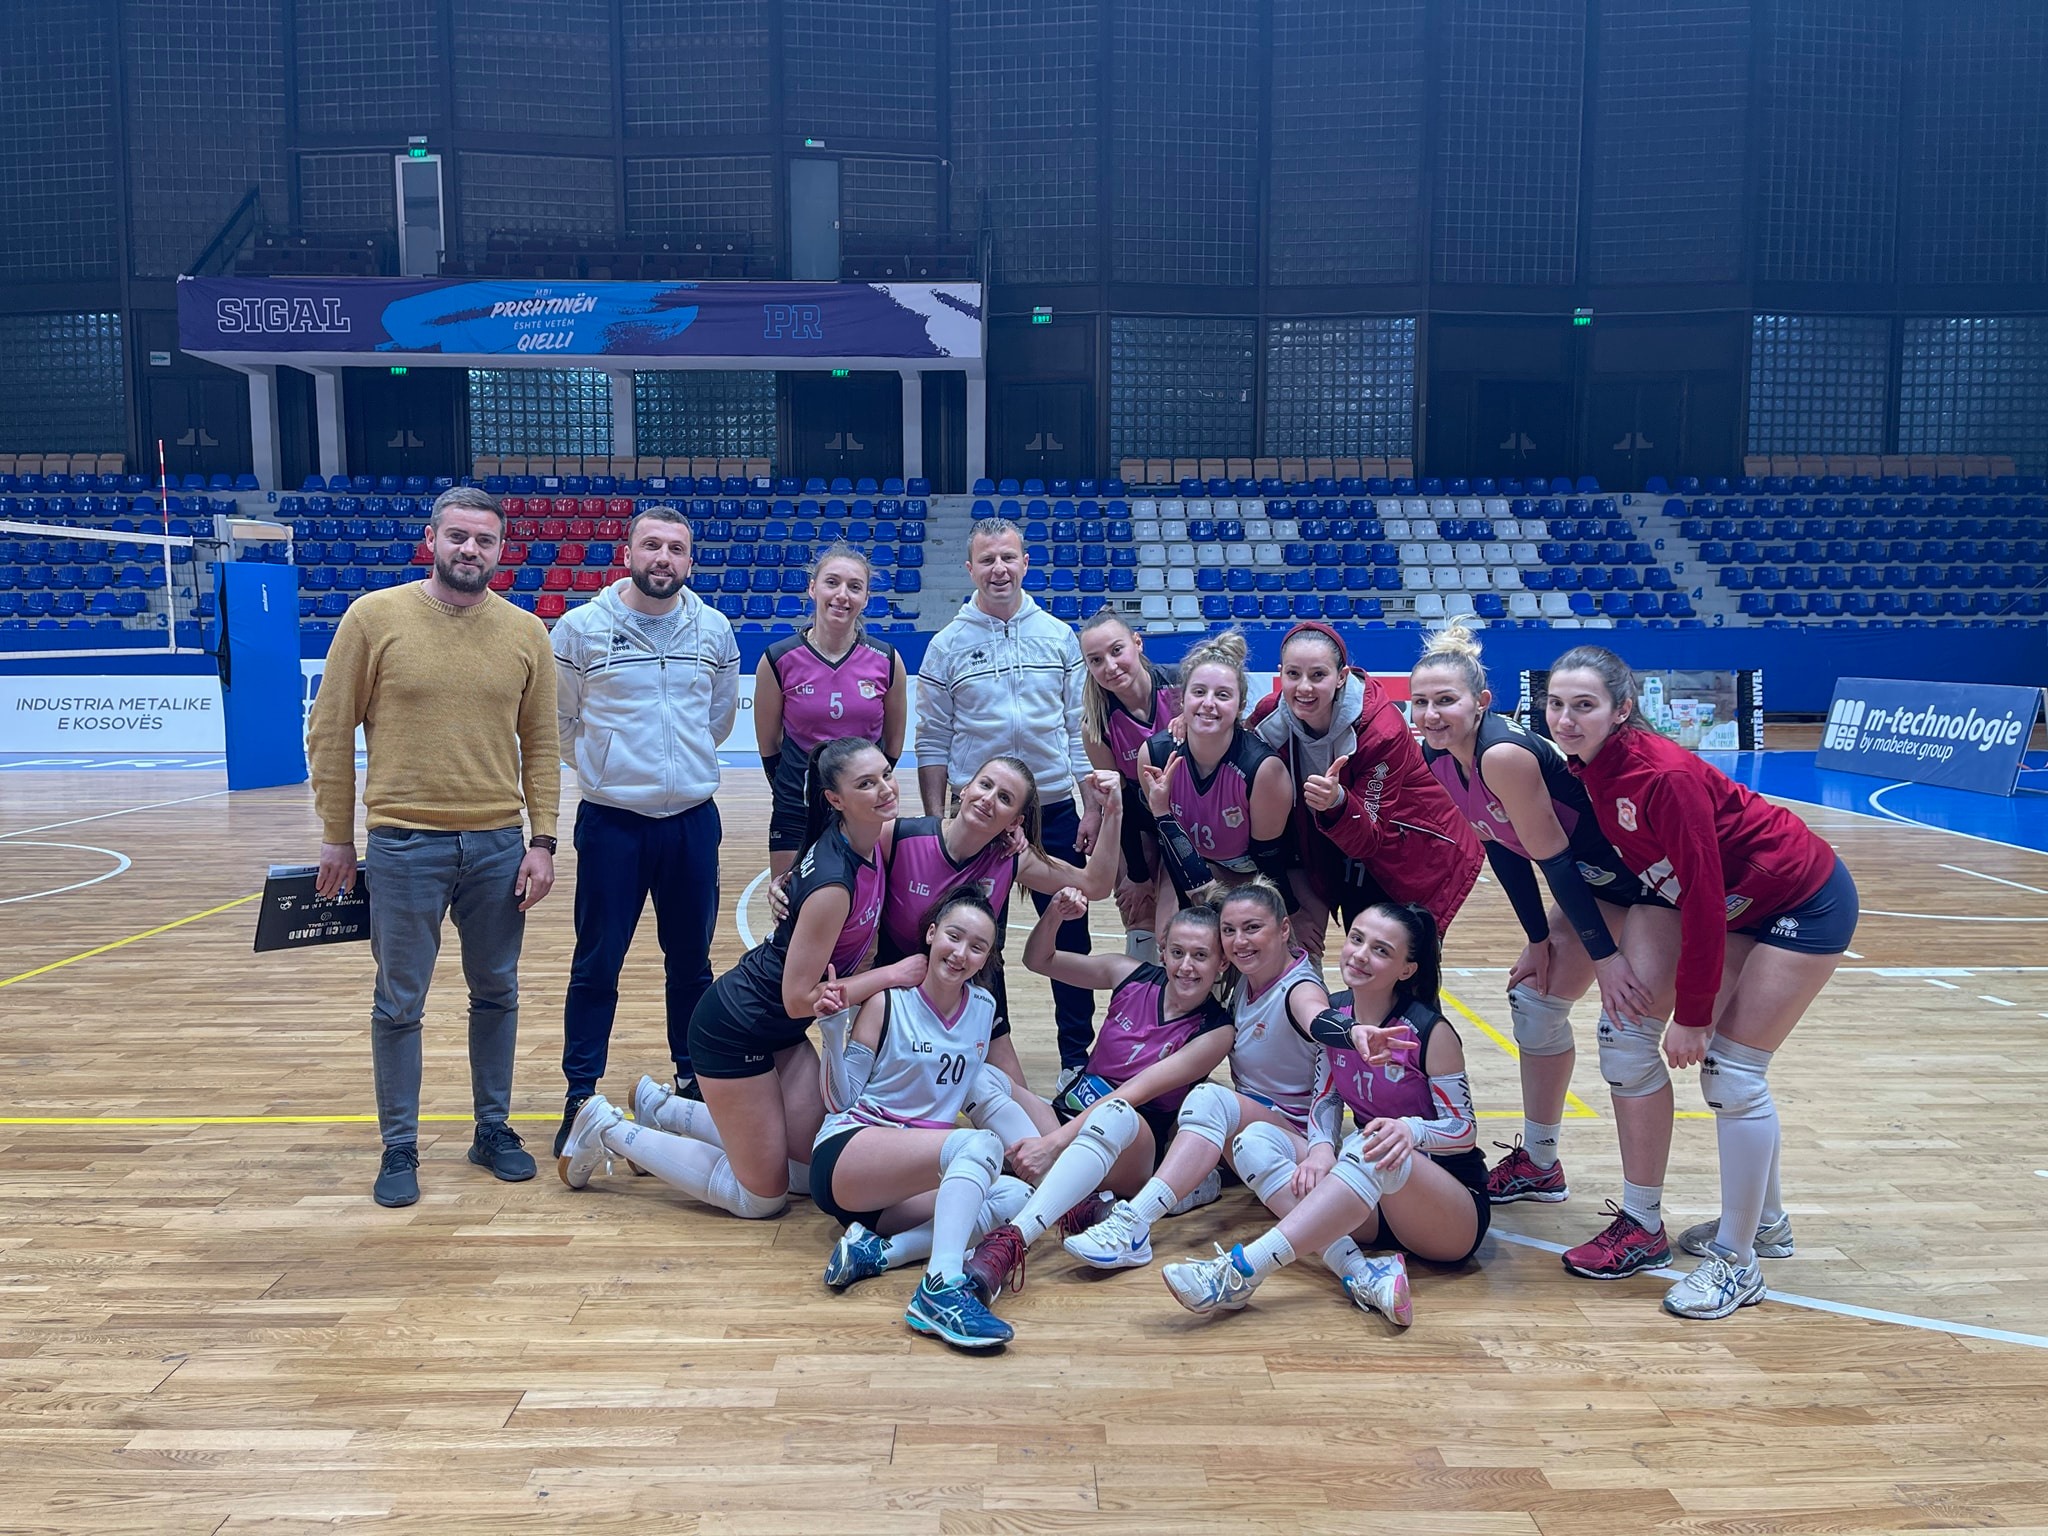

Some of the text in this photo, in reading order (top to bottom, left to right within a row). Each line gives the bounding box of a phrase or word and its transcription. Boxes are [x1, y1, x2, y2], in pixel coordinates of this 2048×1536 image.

[535, 288, 553, 297] MBI
[490, 292, 598, 319] PRISHTINËN
[217, 298, 351, 333] SIGAL
[764, 304, 823, 339] PR
[516, 331, 574, 352] QIELLI
[267, 491, 277, 503] 8
[1622, 494, 1632, 506] 8
[1638, 516, 1648, 528] 7
[1654, 538, 1665, 550] 6
[1674, 562, 1684, 574] 5
[181, 587, 193, 599] 4
[1692, 587, 1703, 600] 4
[157, 613, 169, 627] 3
[1713, 614, 1724, 627] 3
[1520, 670, 1534, 712] TJETËR
[16, 697, 213, 711] INDUSTRIA METALIKE
[829, 691, 845, 720] 5
[1750, 668, 1764, 750] TJETËR NIVEL
[57, 713, 163, 730] E KOSOVËS
[1864, 704, 2023, 752] m-technologie
[1859, 732, 1954, 763] by mabetex group
[1189, 821, 1216, 851] 13
[325, 924, 359, 936] COACH
[1770, 925, 1798, 938] errea
[912, 1040, 933, 1053] LiG
[935, 1052, 967, 1086] 20
[1077, 1080, 1096, 1106] dre
[1352, 1070, 1374, 1103] 17
